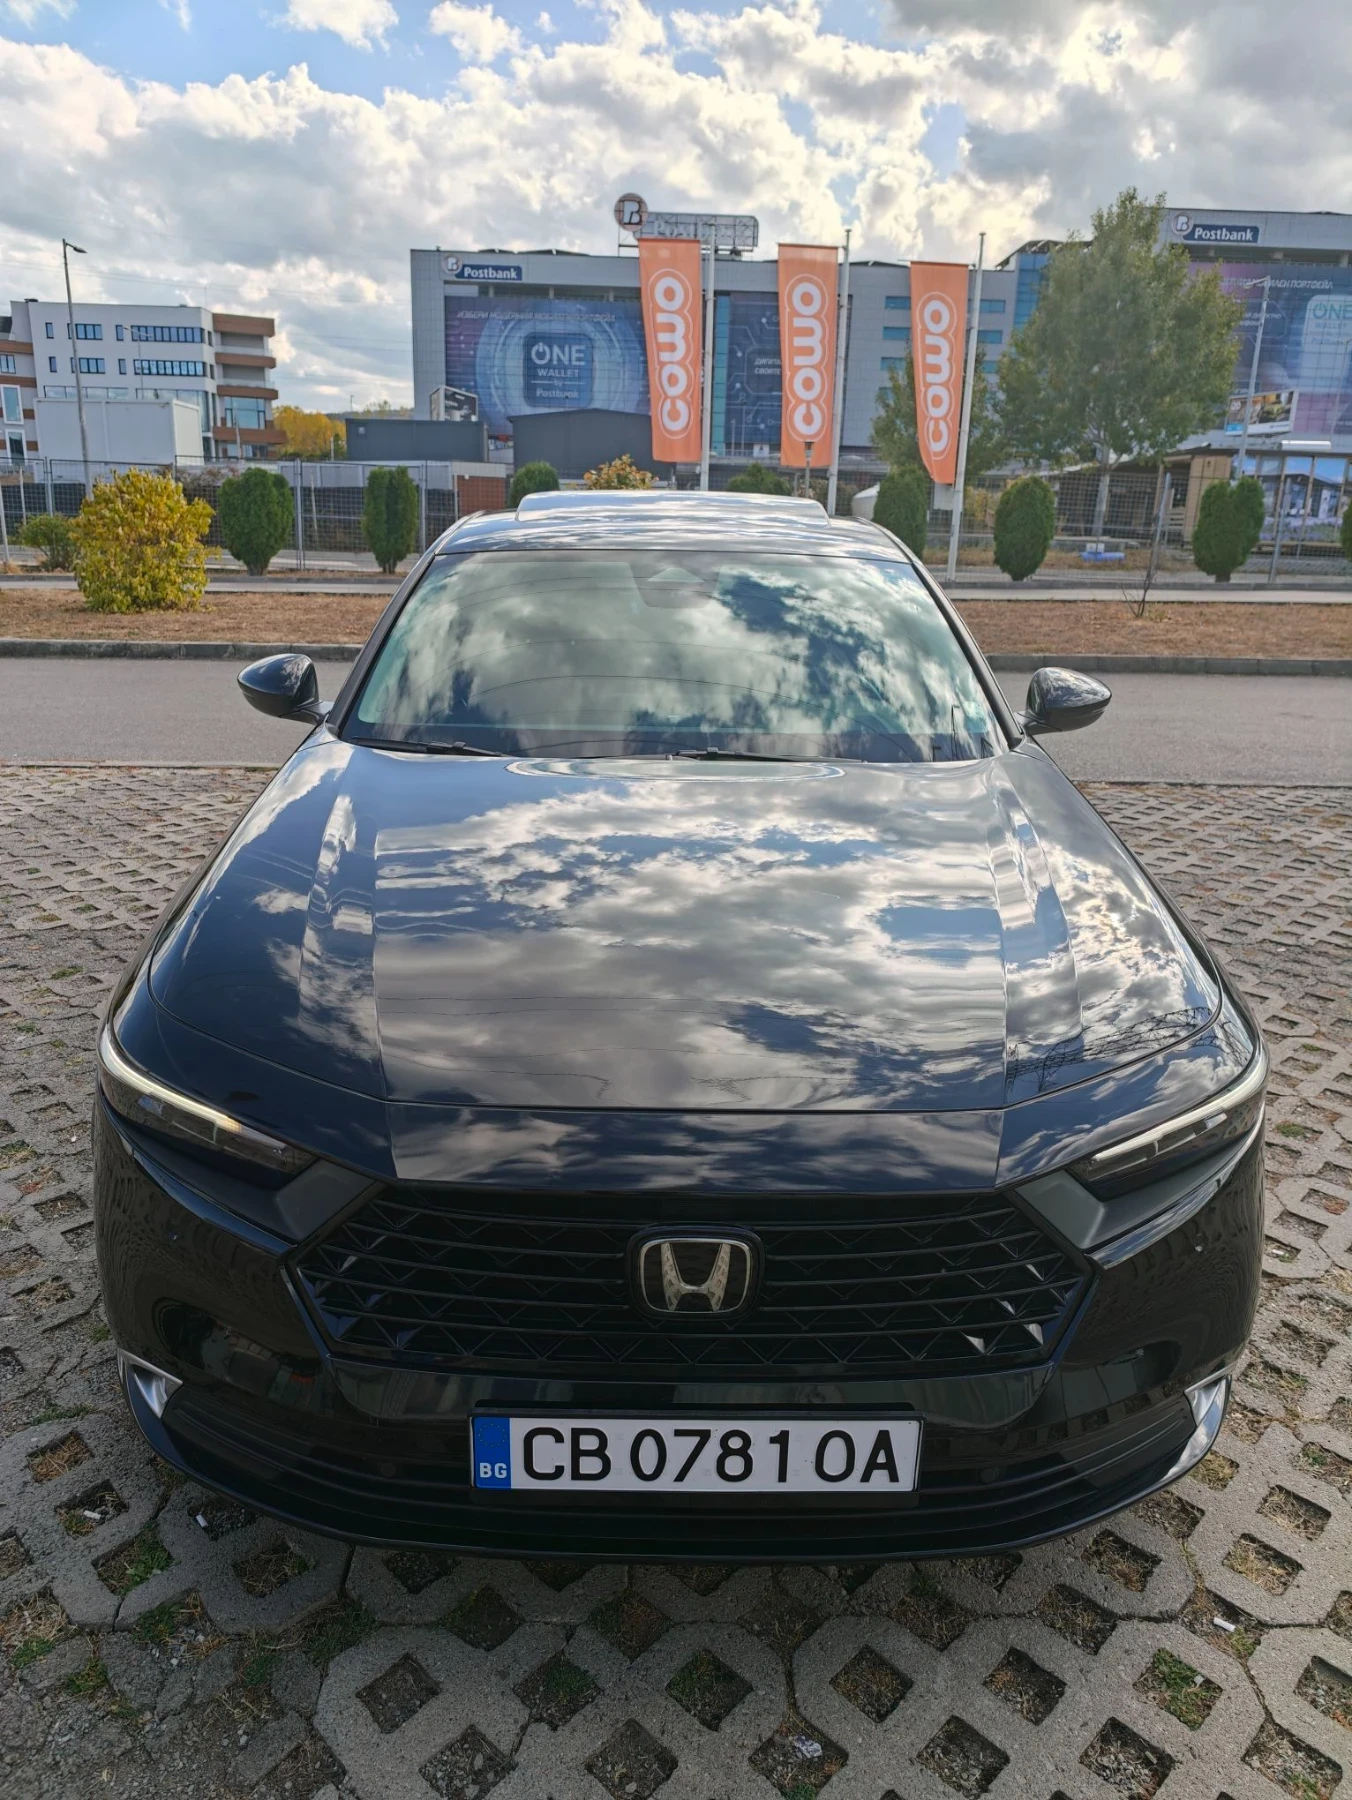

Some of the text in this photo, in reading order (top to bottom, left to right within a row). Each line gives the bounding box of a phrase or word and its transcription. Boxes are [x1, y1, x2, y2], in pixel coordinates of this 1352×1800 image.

[1194, 226, 1253, 242] Postbank
[464, 266, 518, 281] Postbank
[531, 342, 586, 366] ONE
[537, 368, 580, 378] WALLET
[537, 388, 579, 398] Postbank
[479, 1427, 899, 1484] BG CB 0781 OA
